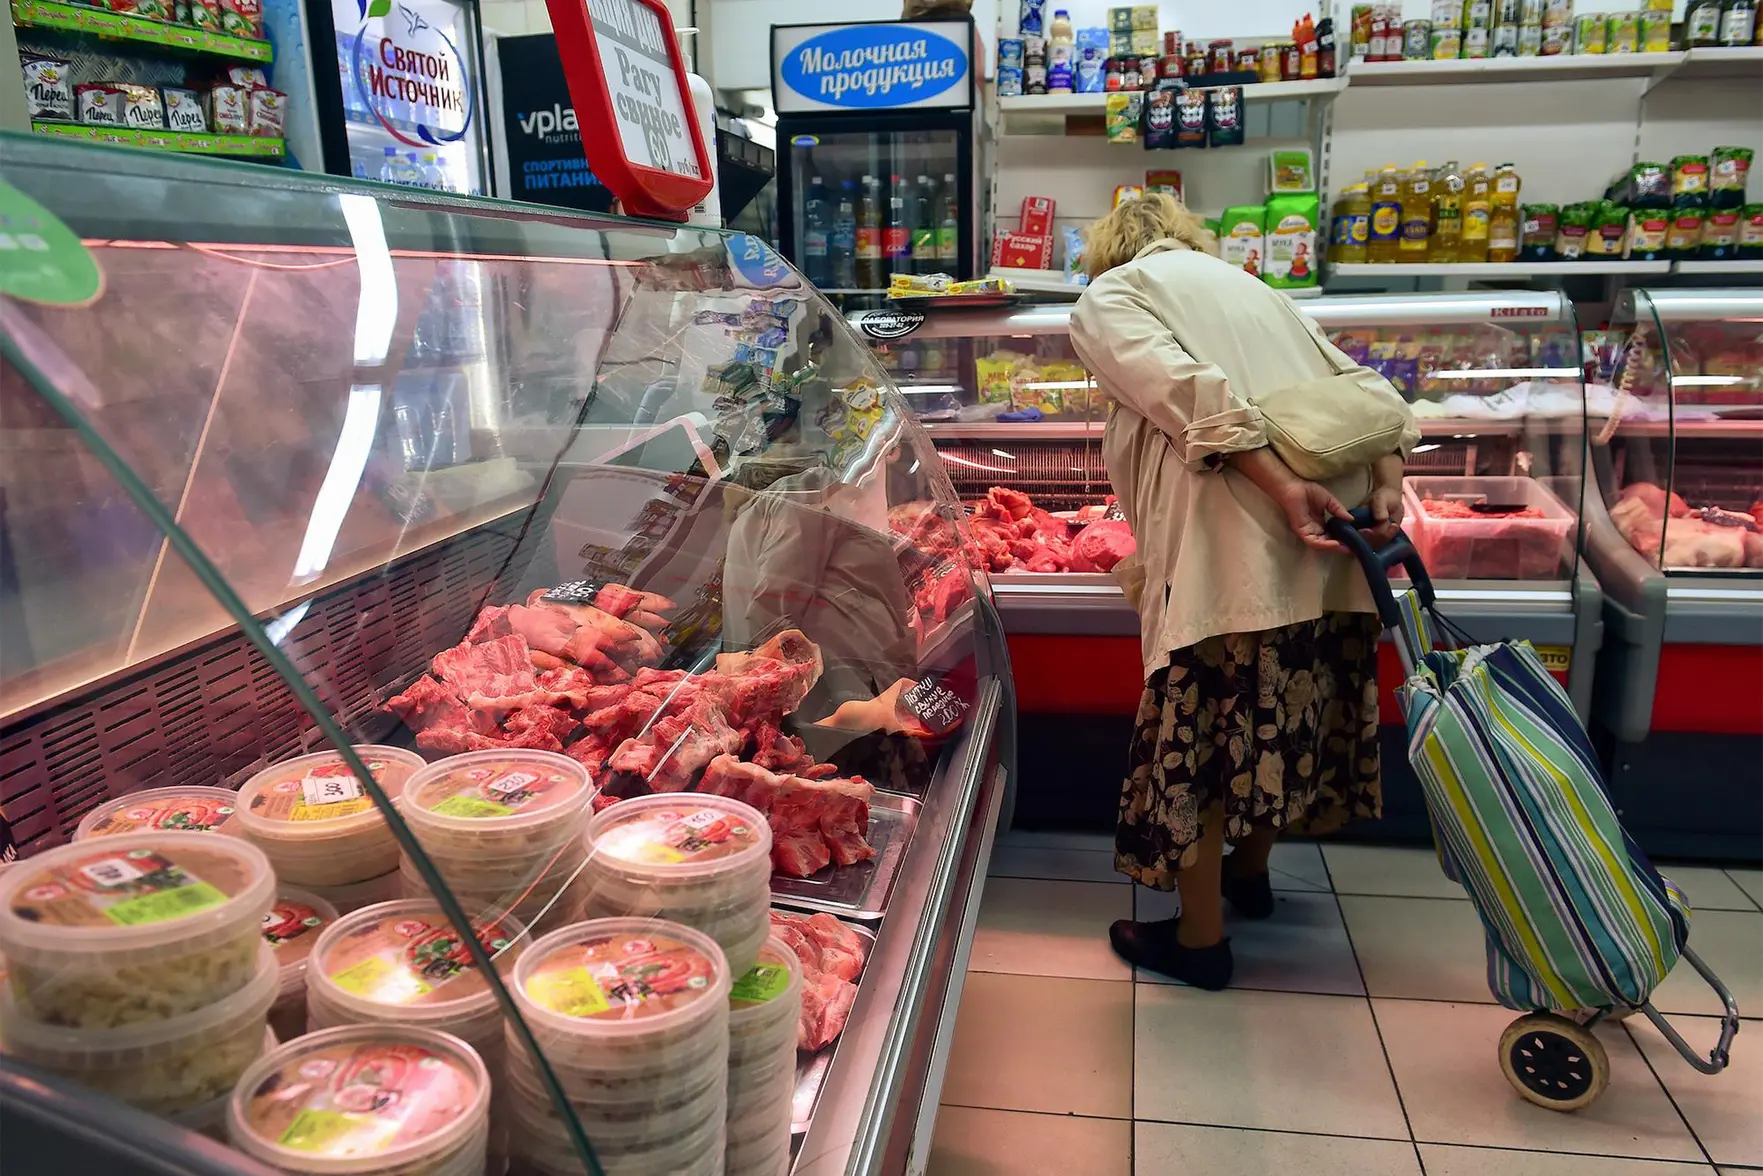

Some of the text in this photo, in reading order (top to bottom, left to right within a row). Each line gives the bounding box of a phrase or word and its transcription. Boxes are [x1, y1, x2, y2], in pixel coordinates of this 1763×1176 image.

[632, 2, 667, 55] ДНЯ
[380, 37, 449, 81] СВЯТОЙ
[614, 47, 662, 108] Рагу
[800, 39, 927, 75] Молочная
[820, 58, 955, 100] продукция
[369, 64, 464, 112] ИСТОЧНИК
[616, 92, 682, 140] свиное
[649, 130, 671, 167] 60
